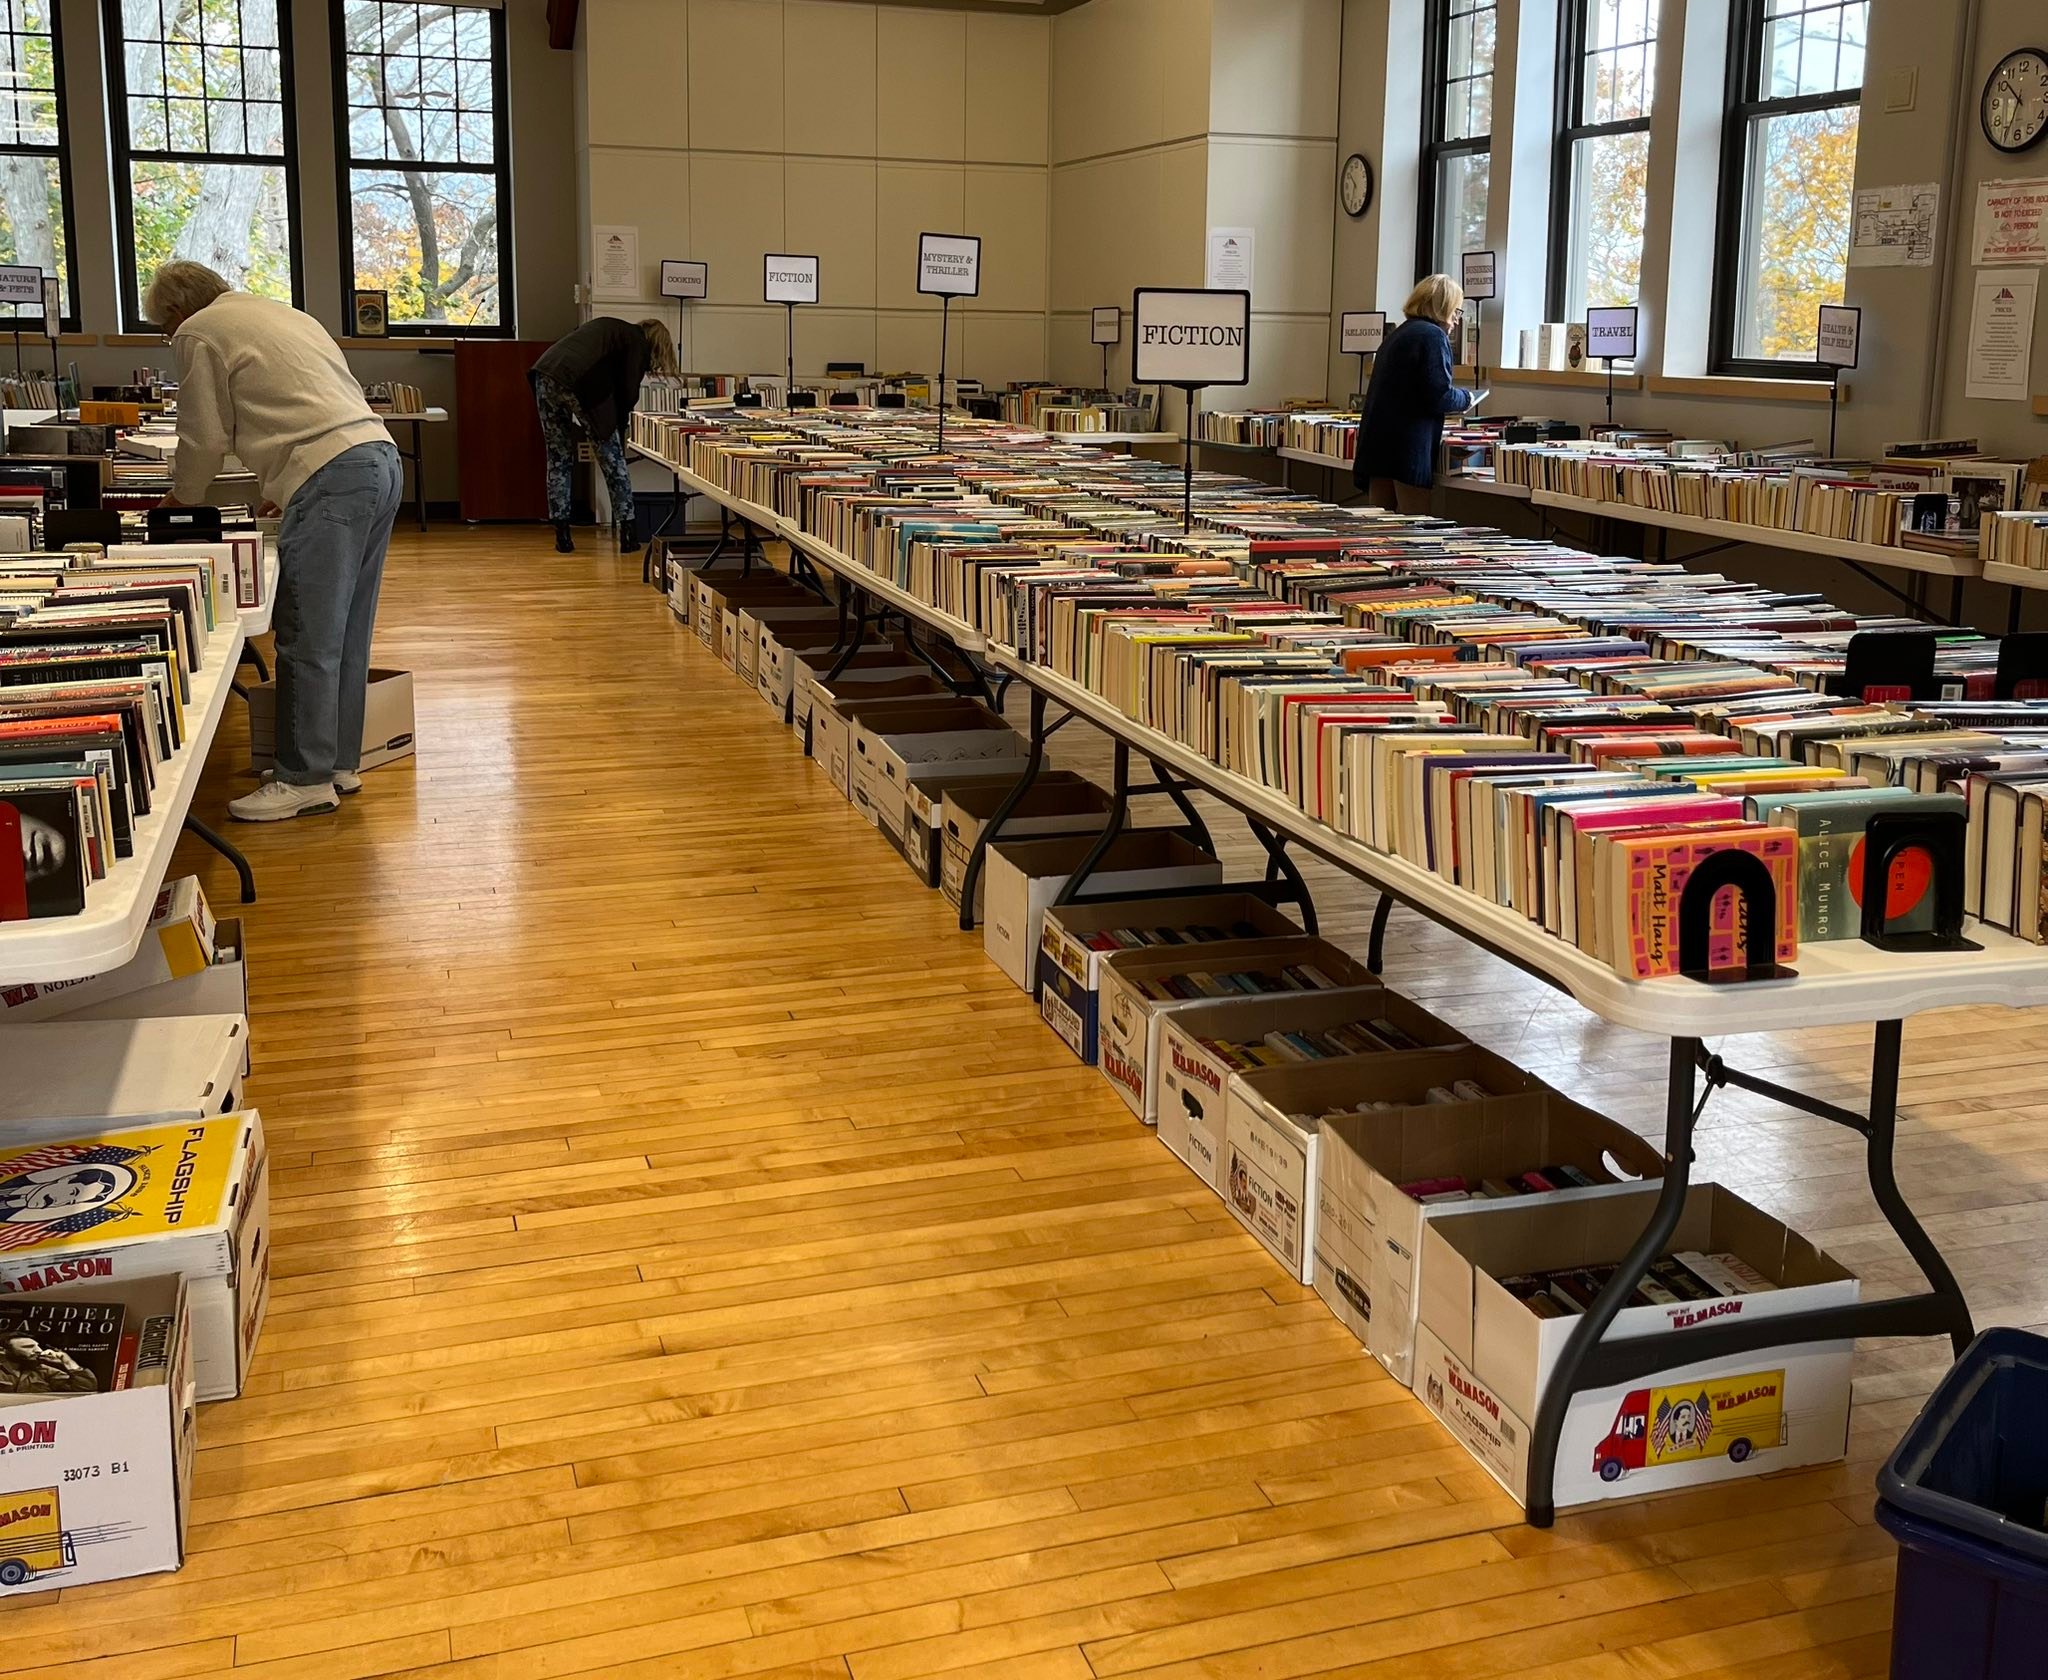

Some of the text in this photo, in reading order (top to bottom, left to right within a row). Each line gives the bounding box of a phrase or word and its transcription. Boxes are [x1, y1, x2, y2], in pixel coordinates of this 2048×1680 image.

[2019, 60, 2030, 73] 12
[2007, 68, 2015, 79] 11
[1997, 80, 2008, 92] 10
[2040, 75, 2048, 87] 2
[1992, 98, 1999, 110] 9
[2037, 109, 2044, 120] 4
[1993, 115, 2001, 127] 8
[2014, 129, 2021, 141] 6
[2026, 123, 2034, 135] 5
[923, 253, 973, 264] MYSTERY &
[926, 265, 969, 276] THRILLER
[0, 274, 37, 283] ATURE
[667, 276, 702, 285] COOKING
[768, 272, 813, 284] FICTION
[8, 285, 35, 294] PETS
[1344, 328, 1382, 337] RELIGION
[1592, 326, 1634, 338] TRAVEL
[1822, 323, 1854, 336] HEALTH &
[1142, 325, 1244, 347] FICTION
[1821, 336, 1854, 349] SELF HELP
[1817, 819, 1832, 935] ALICE MUNRO
[1650, 864, 1667, 967] Matt Haig
[1188, 1133, 1212, 1164] FICTION
[164, 1127, 205, 1224] FLAGSHIP
[1248, 1175, 1273, 1208] FICTION
[29, 1306, 116, 1321] FIDEL
[0, 1318, 114, 1335] CASTRO
[1455, 1397, 1502, 1448] FLAGSHIP
[16, 1443, 55, 1452] PRINTING
[63, 1460, 130, 1482] 33073 B1
[0, 1504, 51, 1528] MASON
